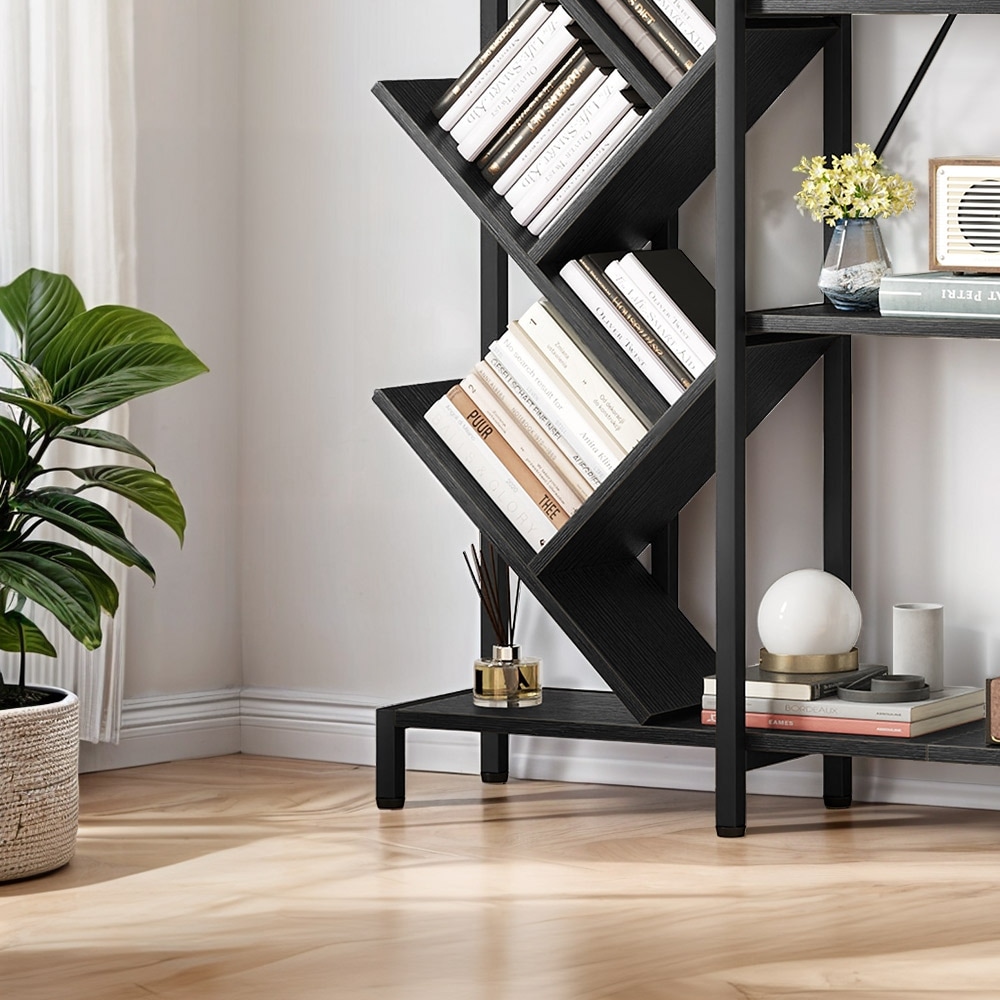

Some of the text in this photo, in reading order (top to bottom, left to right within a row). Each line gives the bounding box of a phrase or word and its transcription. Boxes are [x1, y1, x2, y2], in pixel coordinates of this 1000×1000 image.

[632, 1, 657, 27] DIET
[487, 62, 539, 122] OLIVER TWIST
[525, 108, 548, 133] DIET
[542, 126, 593, 186] OLIVER TWIST
[645, 288, 691, 341] OLIVER TWIST
[942, 290, 982, 302] PETRI
[592, 304, 625, 341] OLIVER
[621, 337, 648, 368] TWIST
[610, 295, 665, 359] Housewise
[501, 337, 516, 353] No
[511, 349, 538, 379] search
[532, 374, 556, 400] result
[550, 396, 565, 411] for
[577, 428, 602, 455] Anita
[464, 408, 494, 440] PUUR
[535, 493, 562, 520] THEE
[768, 719, 794, 727] EAMES
[784, 704, 839, 714] BORDEAUX
